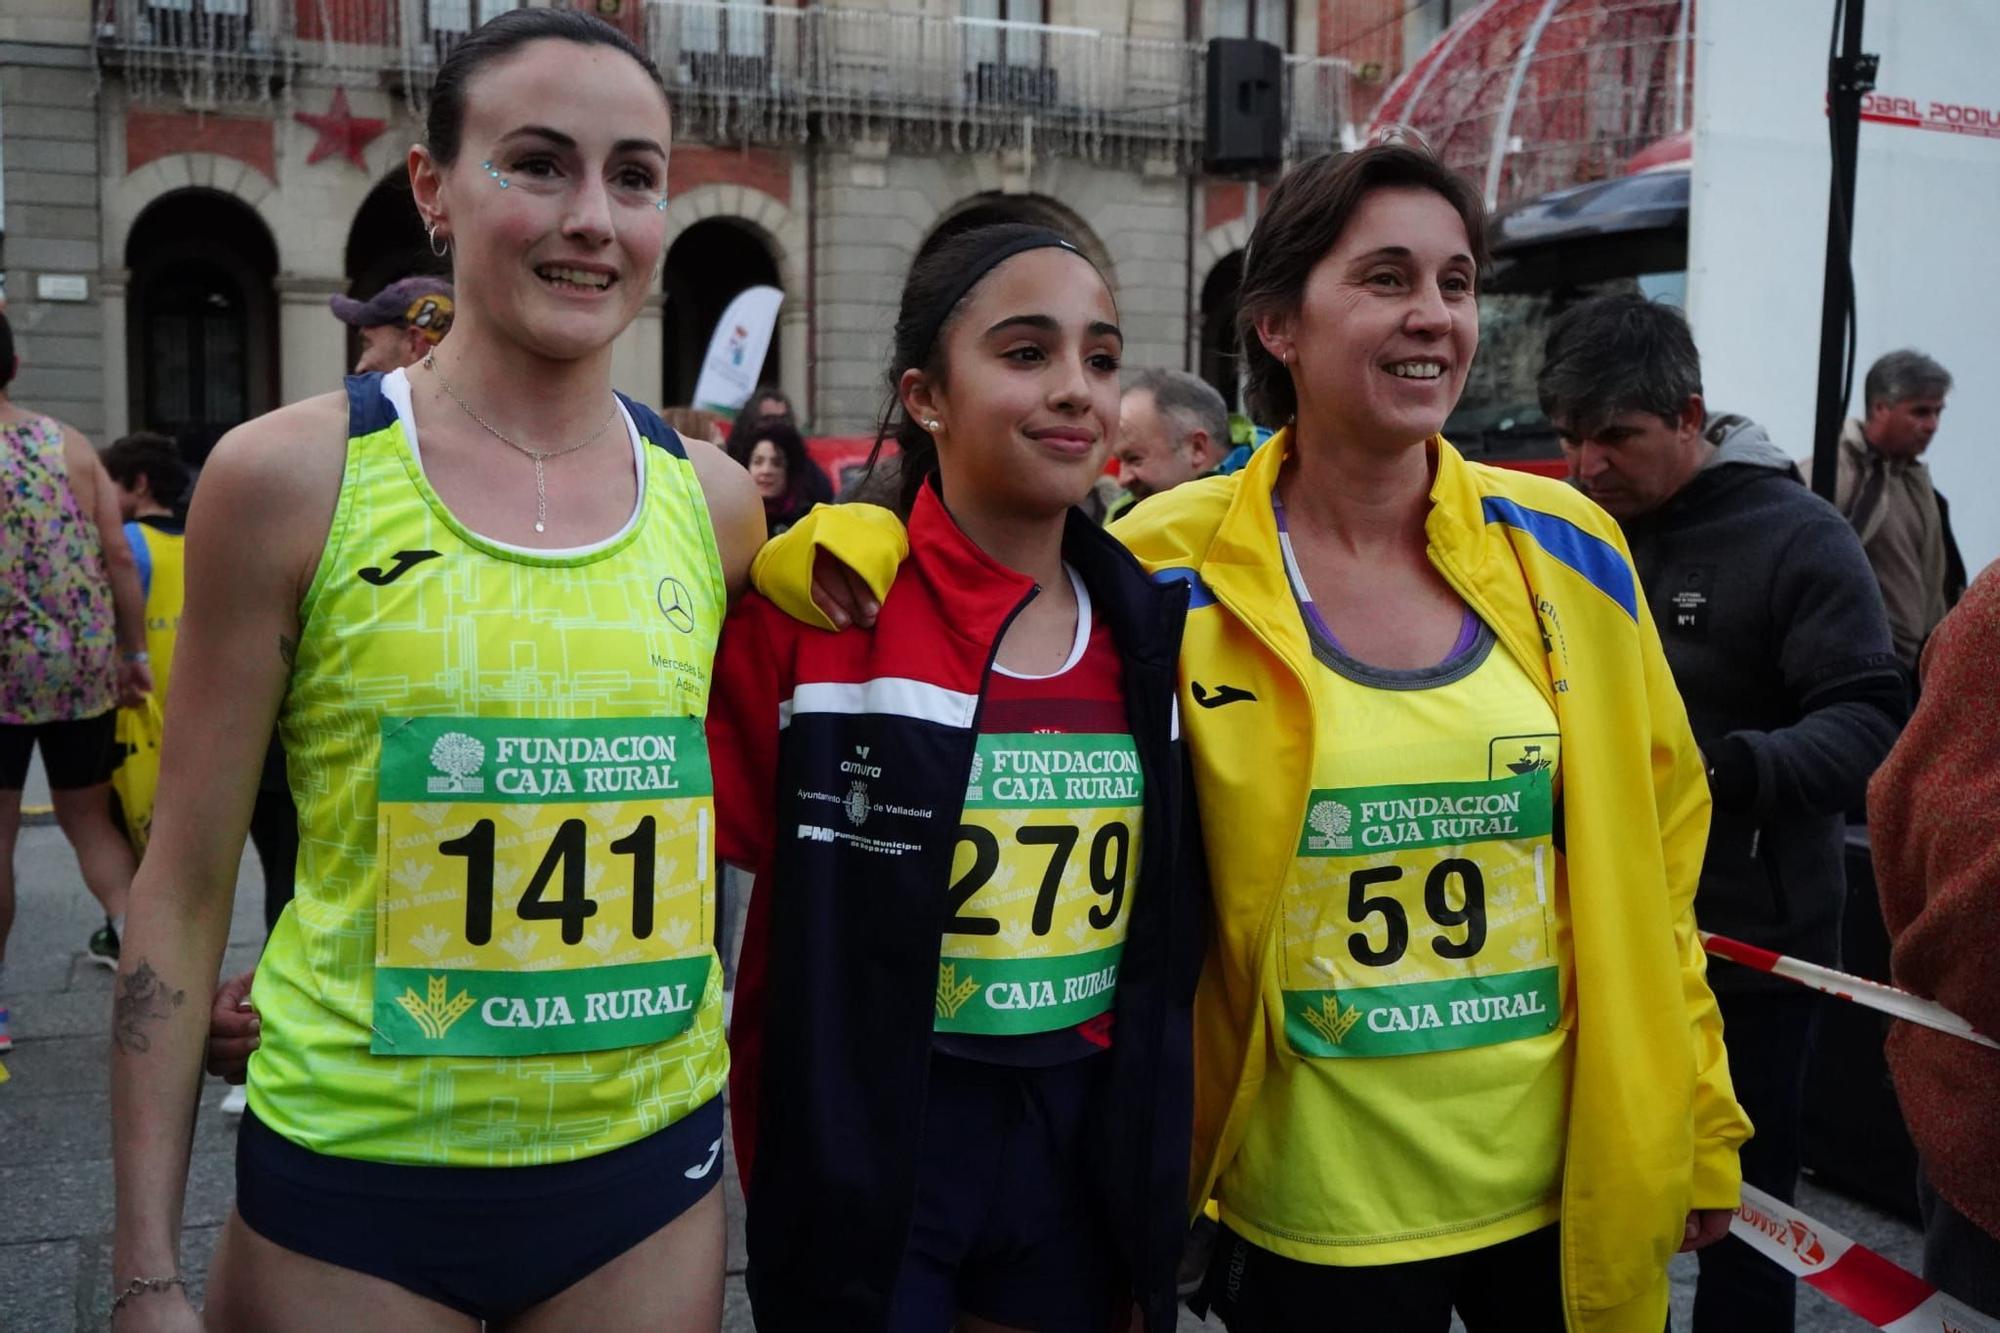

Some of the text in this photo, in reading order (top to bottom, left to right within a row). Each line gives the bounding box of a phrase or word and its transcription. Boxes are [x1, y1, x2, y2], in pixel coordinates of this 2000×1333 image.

[651, 653, 697, 677] Mercedes
[496, 735, 678, 765] FUNDACION
[992, 750, 1139, 774] FUNDACION
[495, 765, 680, 796] CAJA RURAL
[840, 760, 882, 779] amura
[992, 776, 1139, 801] CAJA RURAL
[873, 802, 884, 812] de
[885, 803, 933, 818] Valladolid
[1360, 791, 1521, 823] FUNDACION
[798, 824, 834, 843] FMD
[1361, 815, 1519, 847] CAJA RURAL
[438, 815, 656, 947] 141
[944, 821, 1130, 936] 279
[1347, 858, 1487, 967] 59
[985, 964, 1116, 1010] CAJA RURAL
[481, 983, 693, 1029] CAJA RURAL
[1367, 990, 1546, 1033] CAJA RURAL
